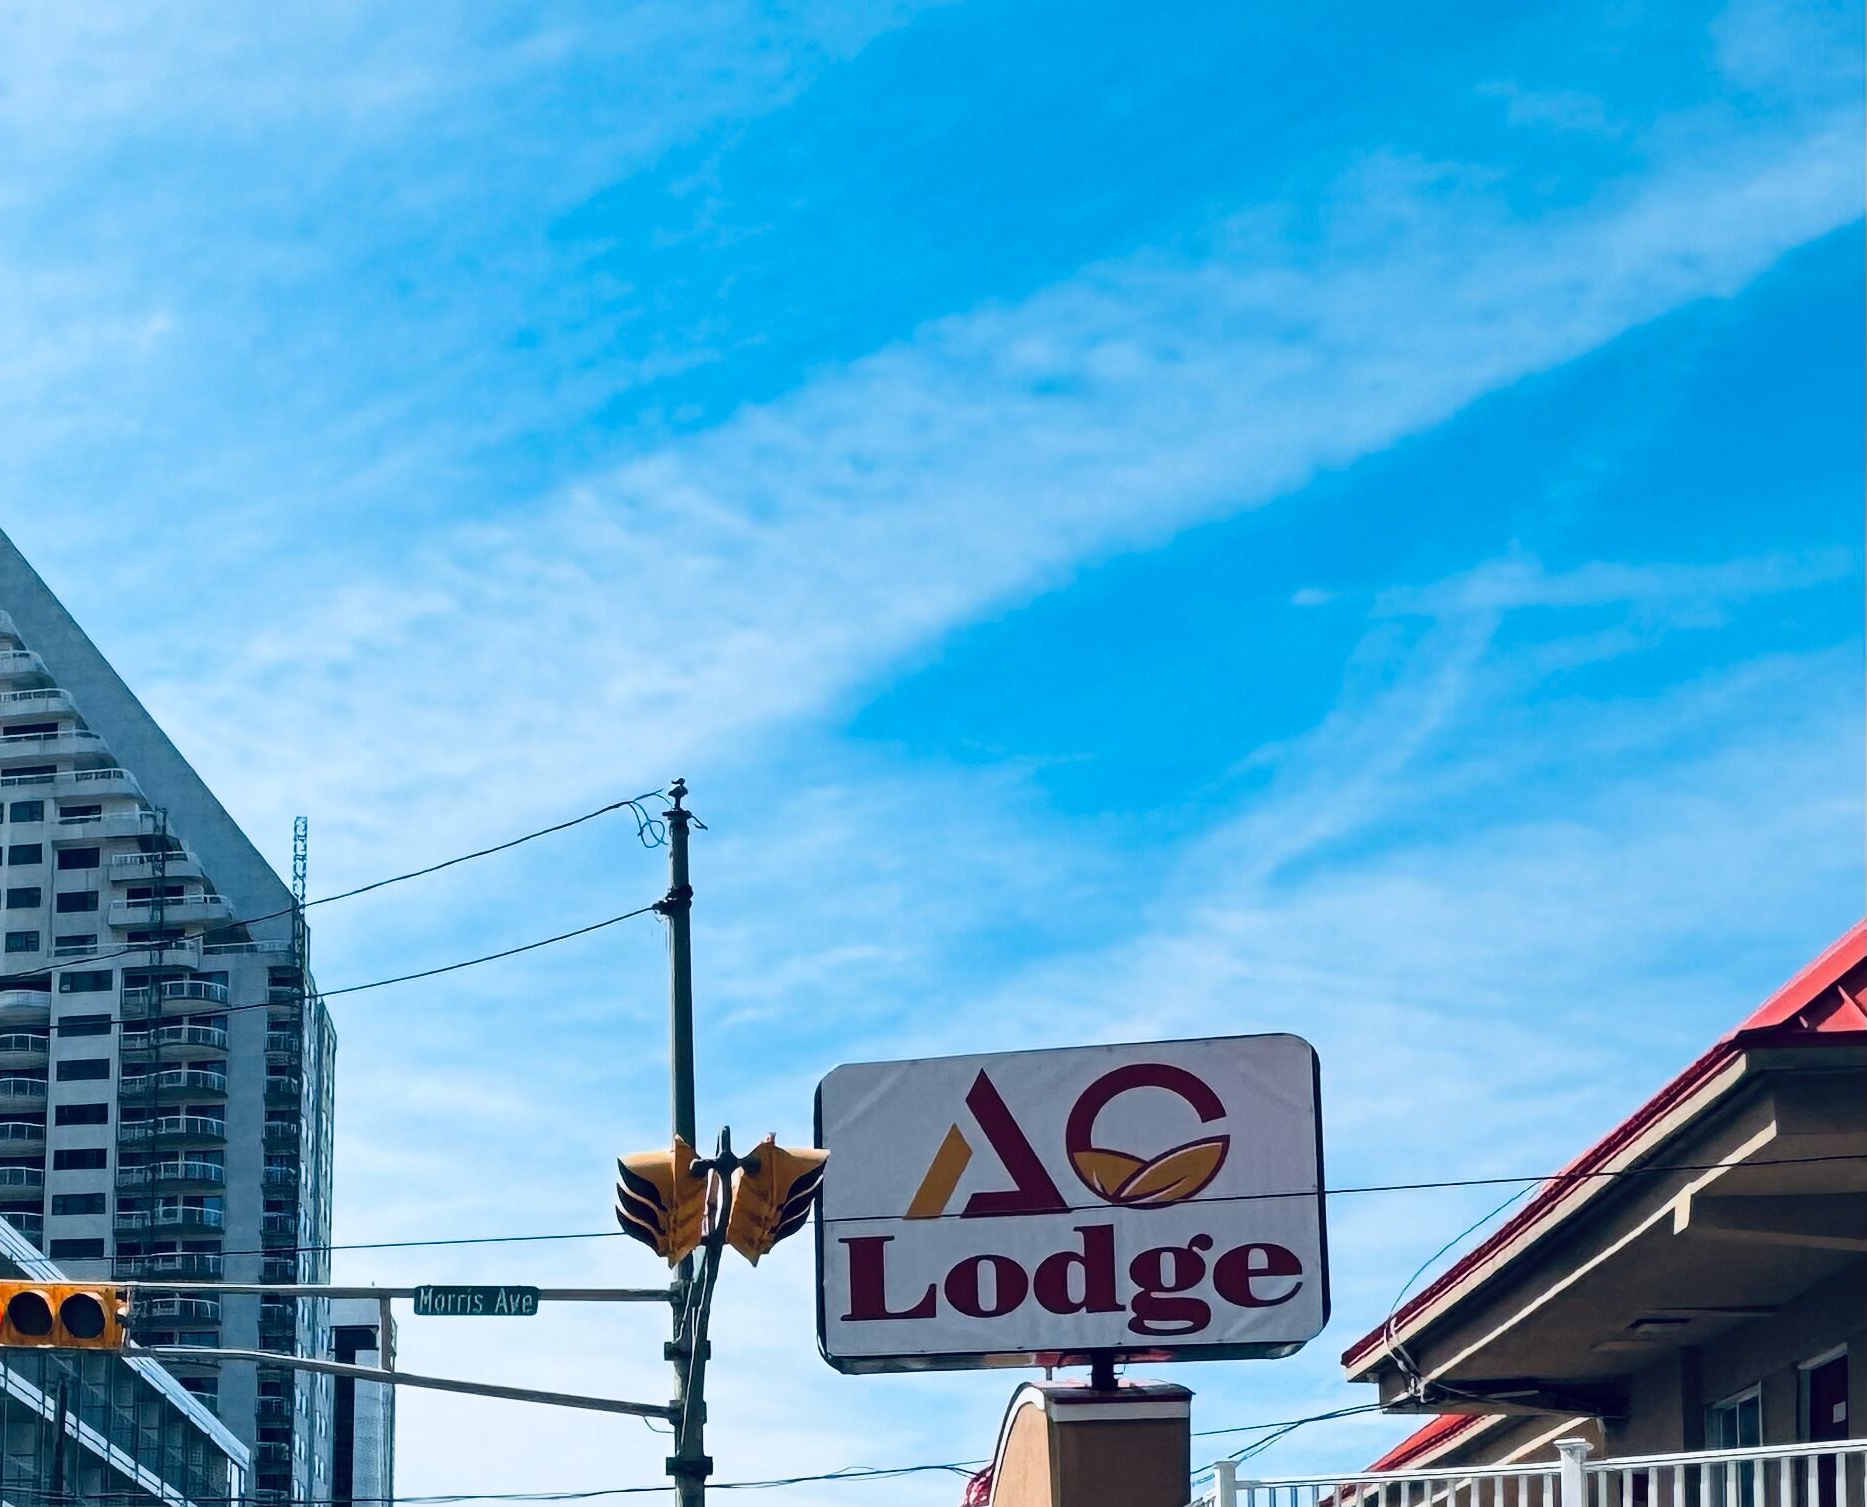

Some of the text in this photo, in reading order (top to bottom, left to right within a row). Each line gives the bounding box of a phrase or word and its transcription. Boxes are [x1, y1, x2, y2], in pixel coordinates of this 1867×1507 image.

[420, 1287, 534, 1313] Morris Ave
[839, 1224, 1303, 1336] Lodge
